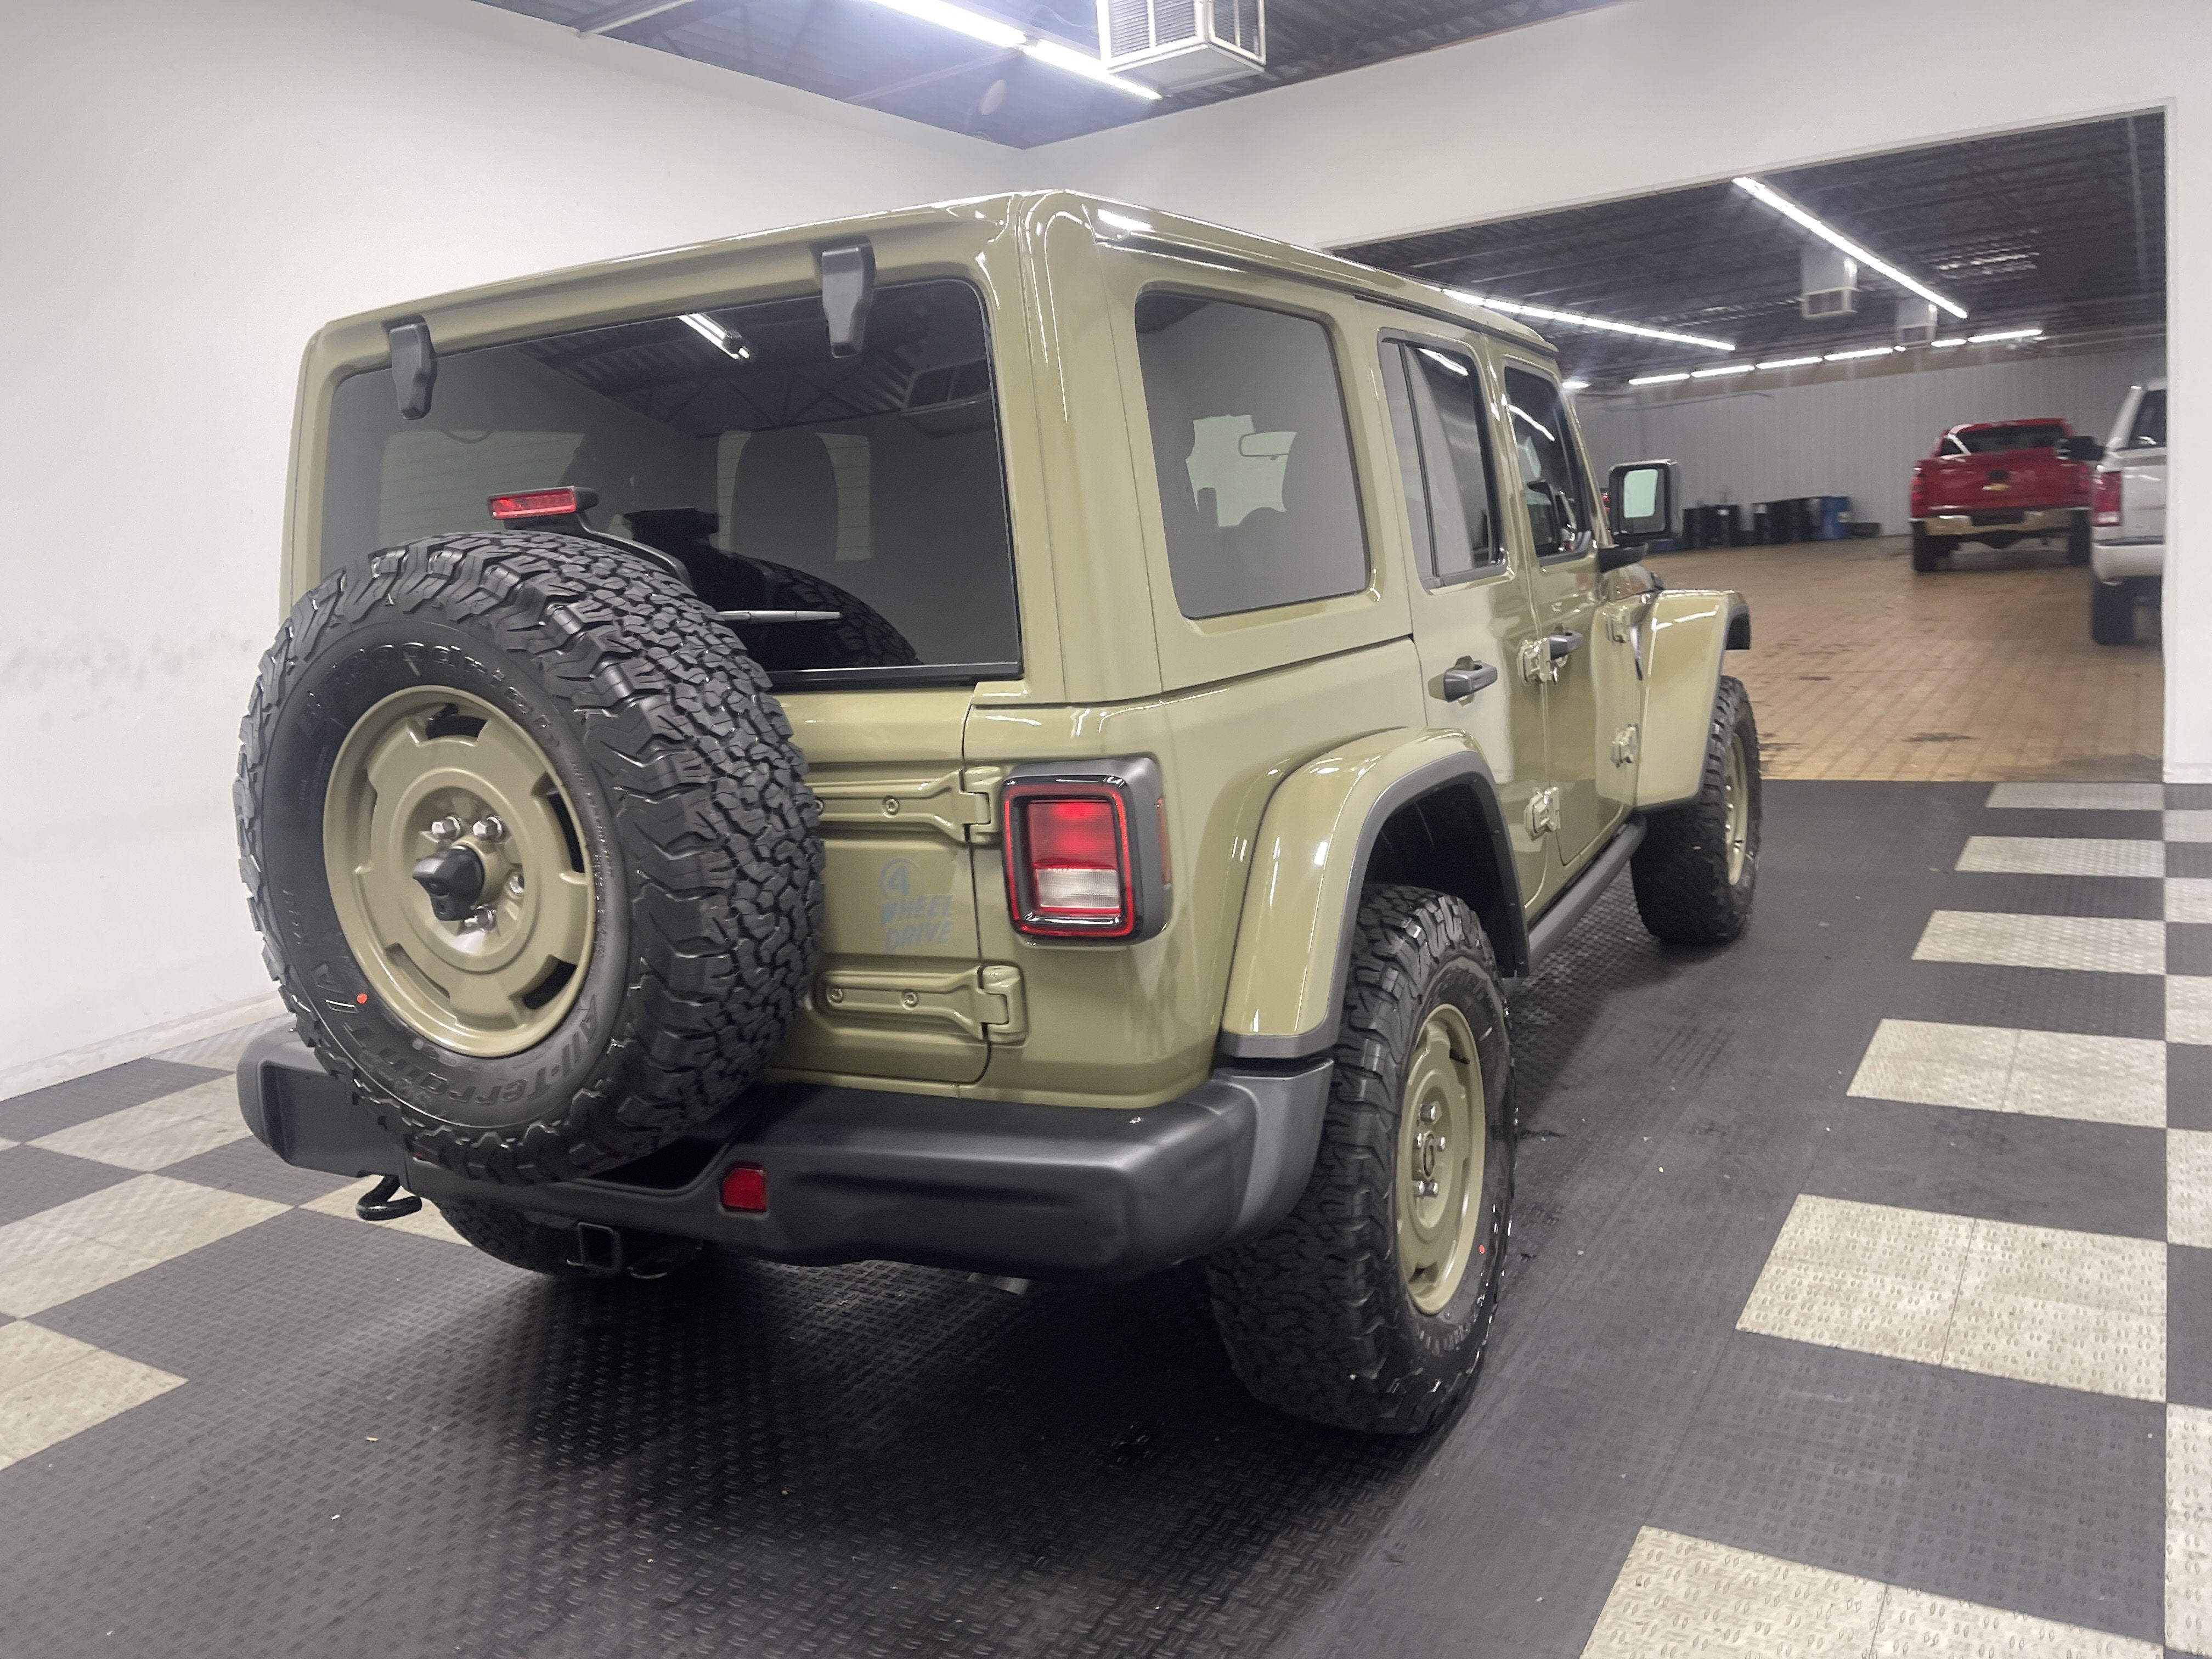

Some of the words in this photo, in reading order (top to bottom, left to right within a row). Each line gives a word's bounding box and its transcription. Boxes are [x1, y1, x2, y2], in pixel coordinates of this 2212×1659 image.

[298, 641, 560, 748] Goodrich
[880, 894, 953, 924] WHEEL
[884, 921, 953, 953] DRIVE
